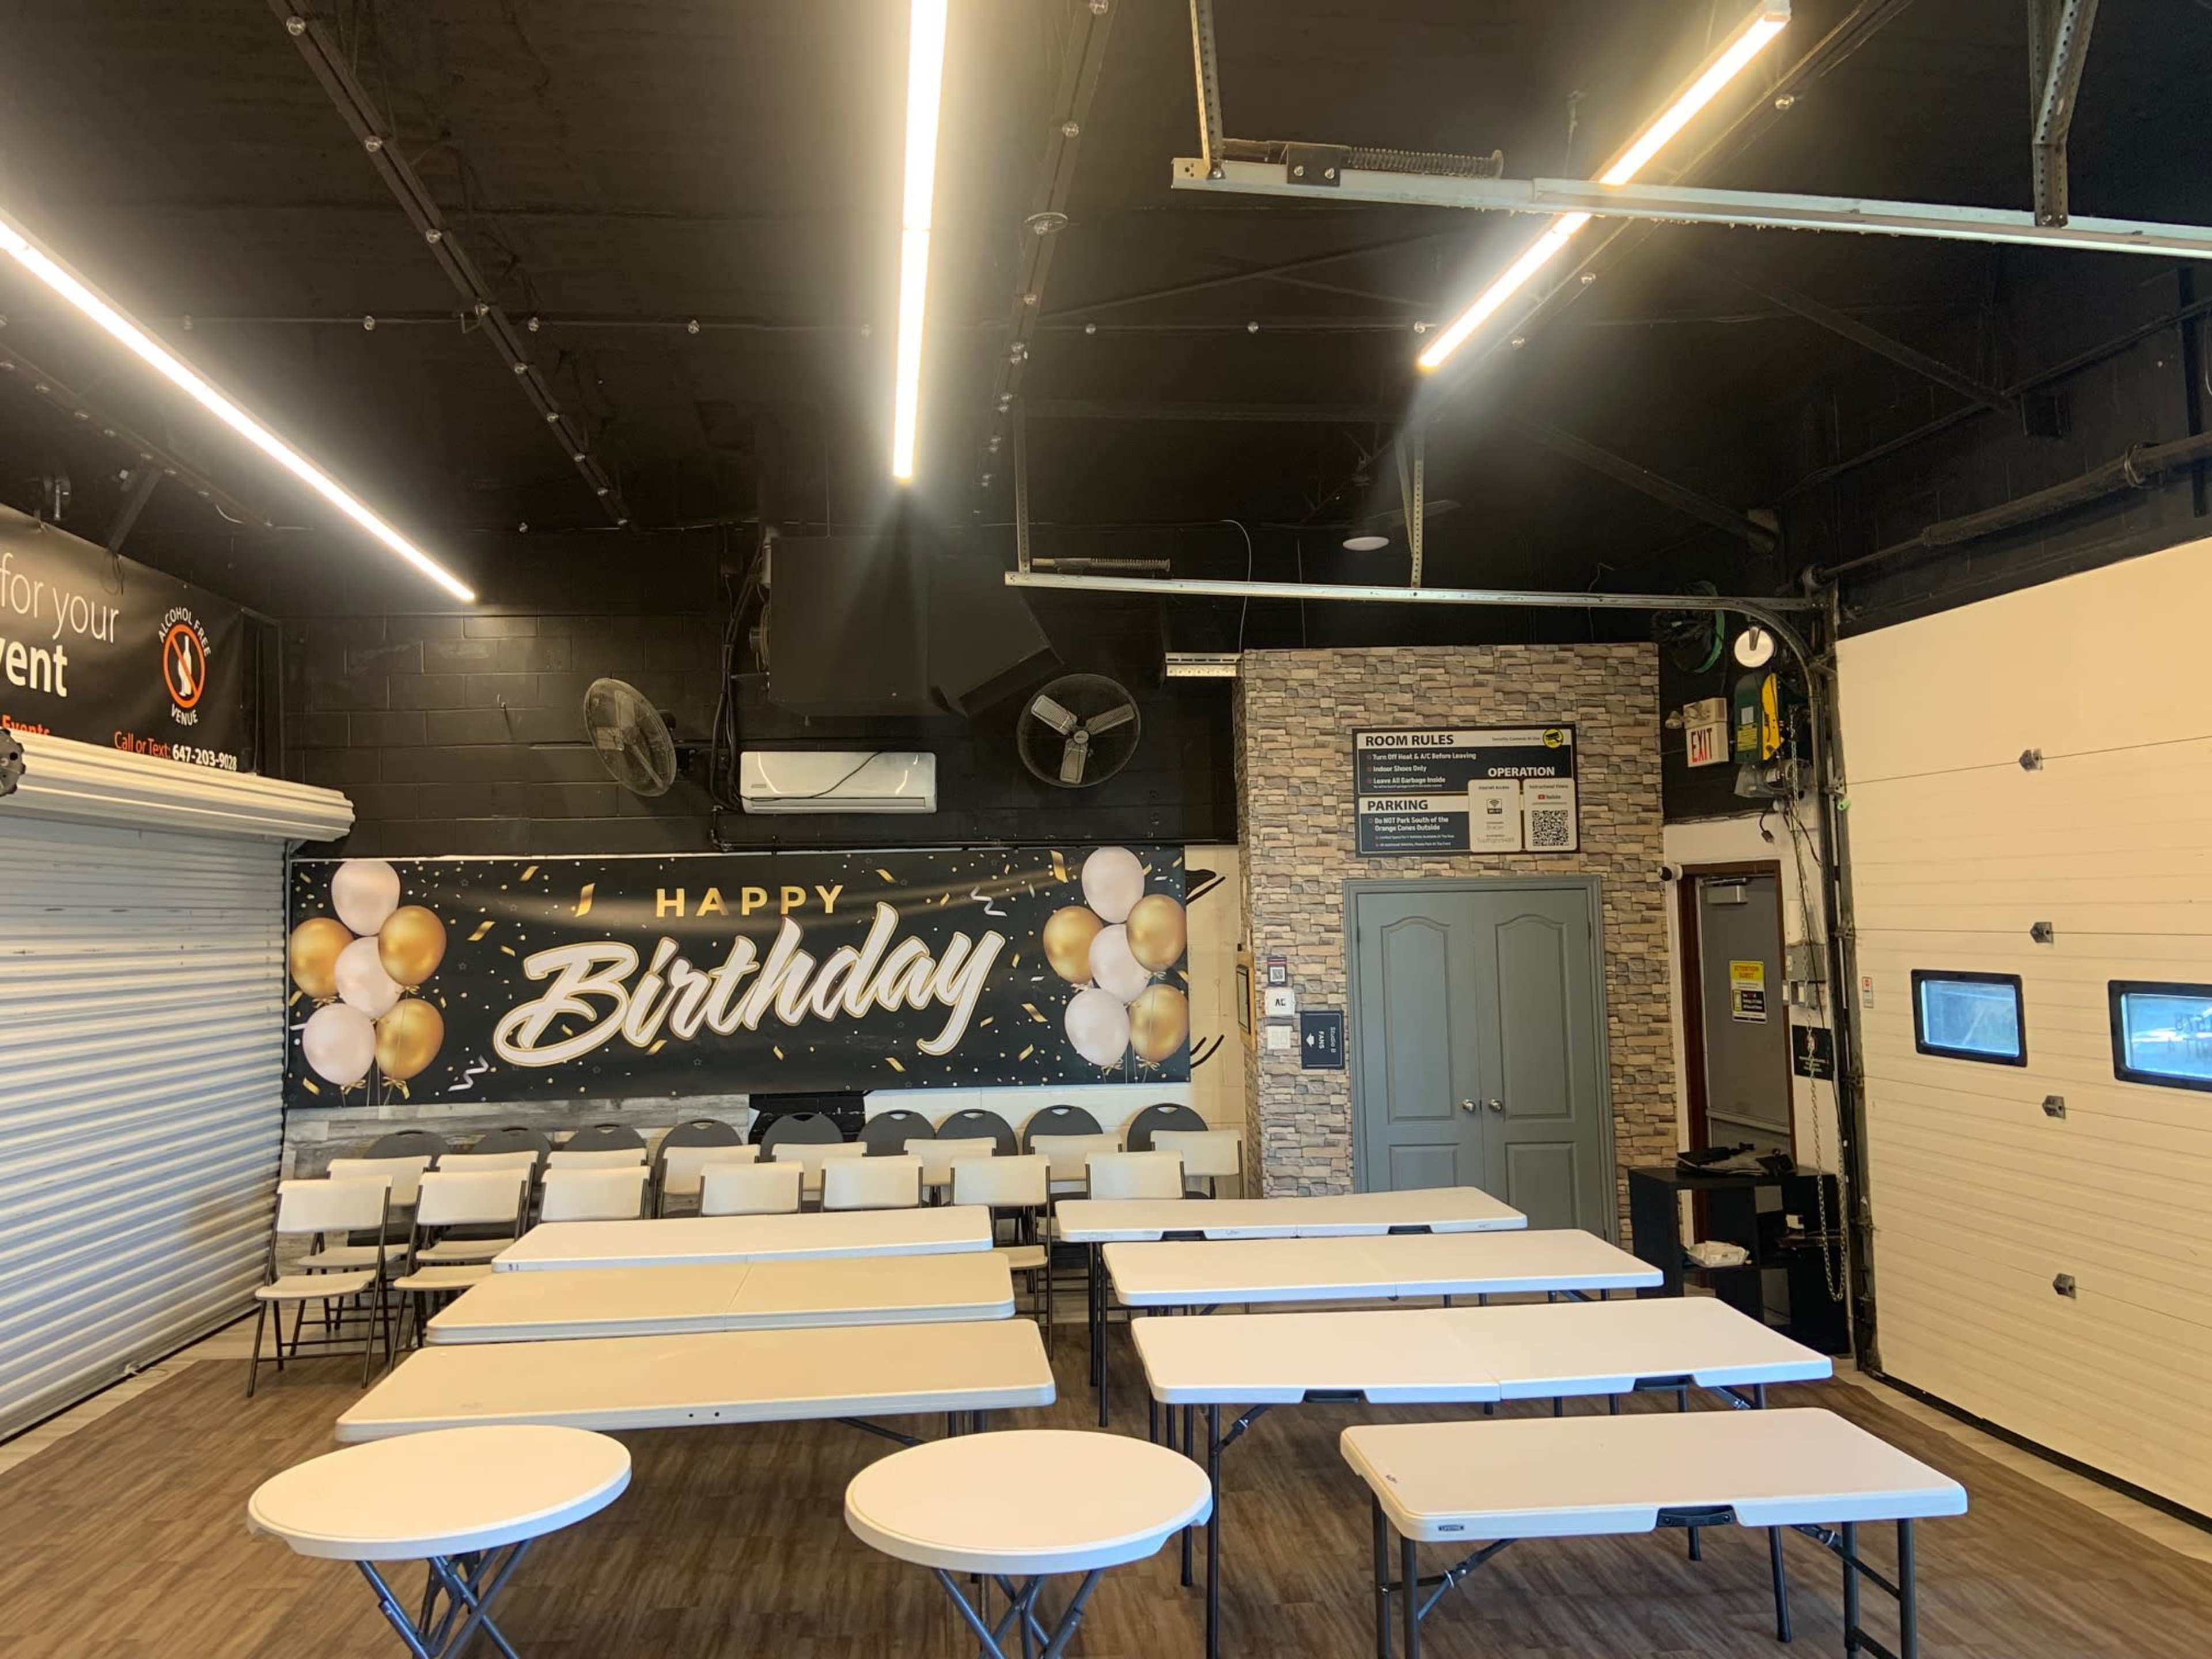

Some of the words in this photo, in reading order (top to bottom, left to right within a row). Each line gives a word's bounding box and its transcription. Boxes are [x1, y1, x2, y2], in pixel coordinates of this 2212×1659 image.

[0, 552, 44, 618] for
[52, 587, 119, 643] your
[158, 607, 192, 643] ALCOHOL
[194, 619, 211, 657] FREE
[171, 703, 198, 726] VENUE
[115, 730, 134, 752] Call
[135, 739, 146, 753] or
[147, 738, 172, 759] Text:
[172, 744, 238, 772] 647-203-9028
[1365, 736, 1408, 747] ROOM
[1411, 734, 1455, 746] RULES
[1691, 727, 1713, 763] EXIT
[1413, 764, 1427, 772] Only
[1488, 766, 1555, 777] OPERATION
[1368, 800, 1429, 811] PARKING
[656, 885, 843, 918] HAPPY
[493, 900, 1006, 1067] Birthday
[1275, 998, 1286, 1006] AC
